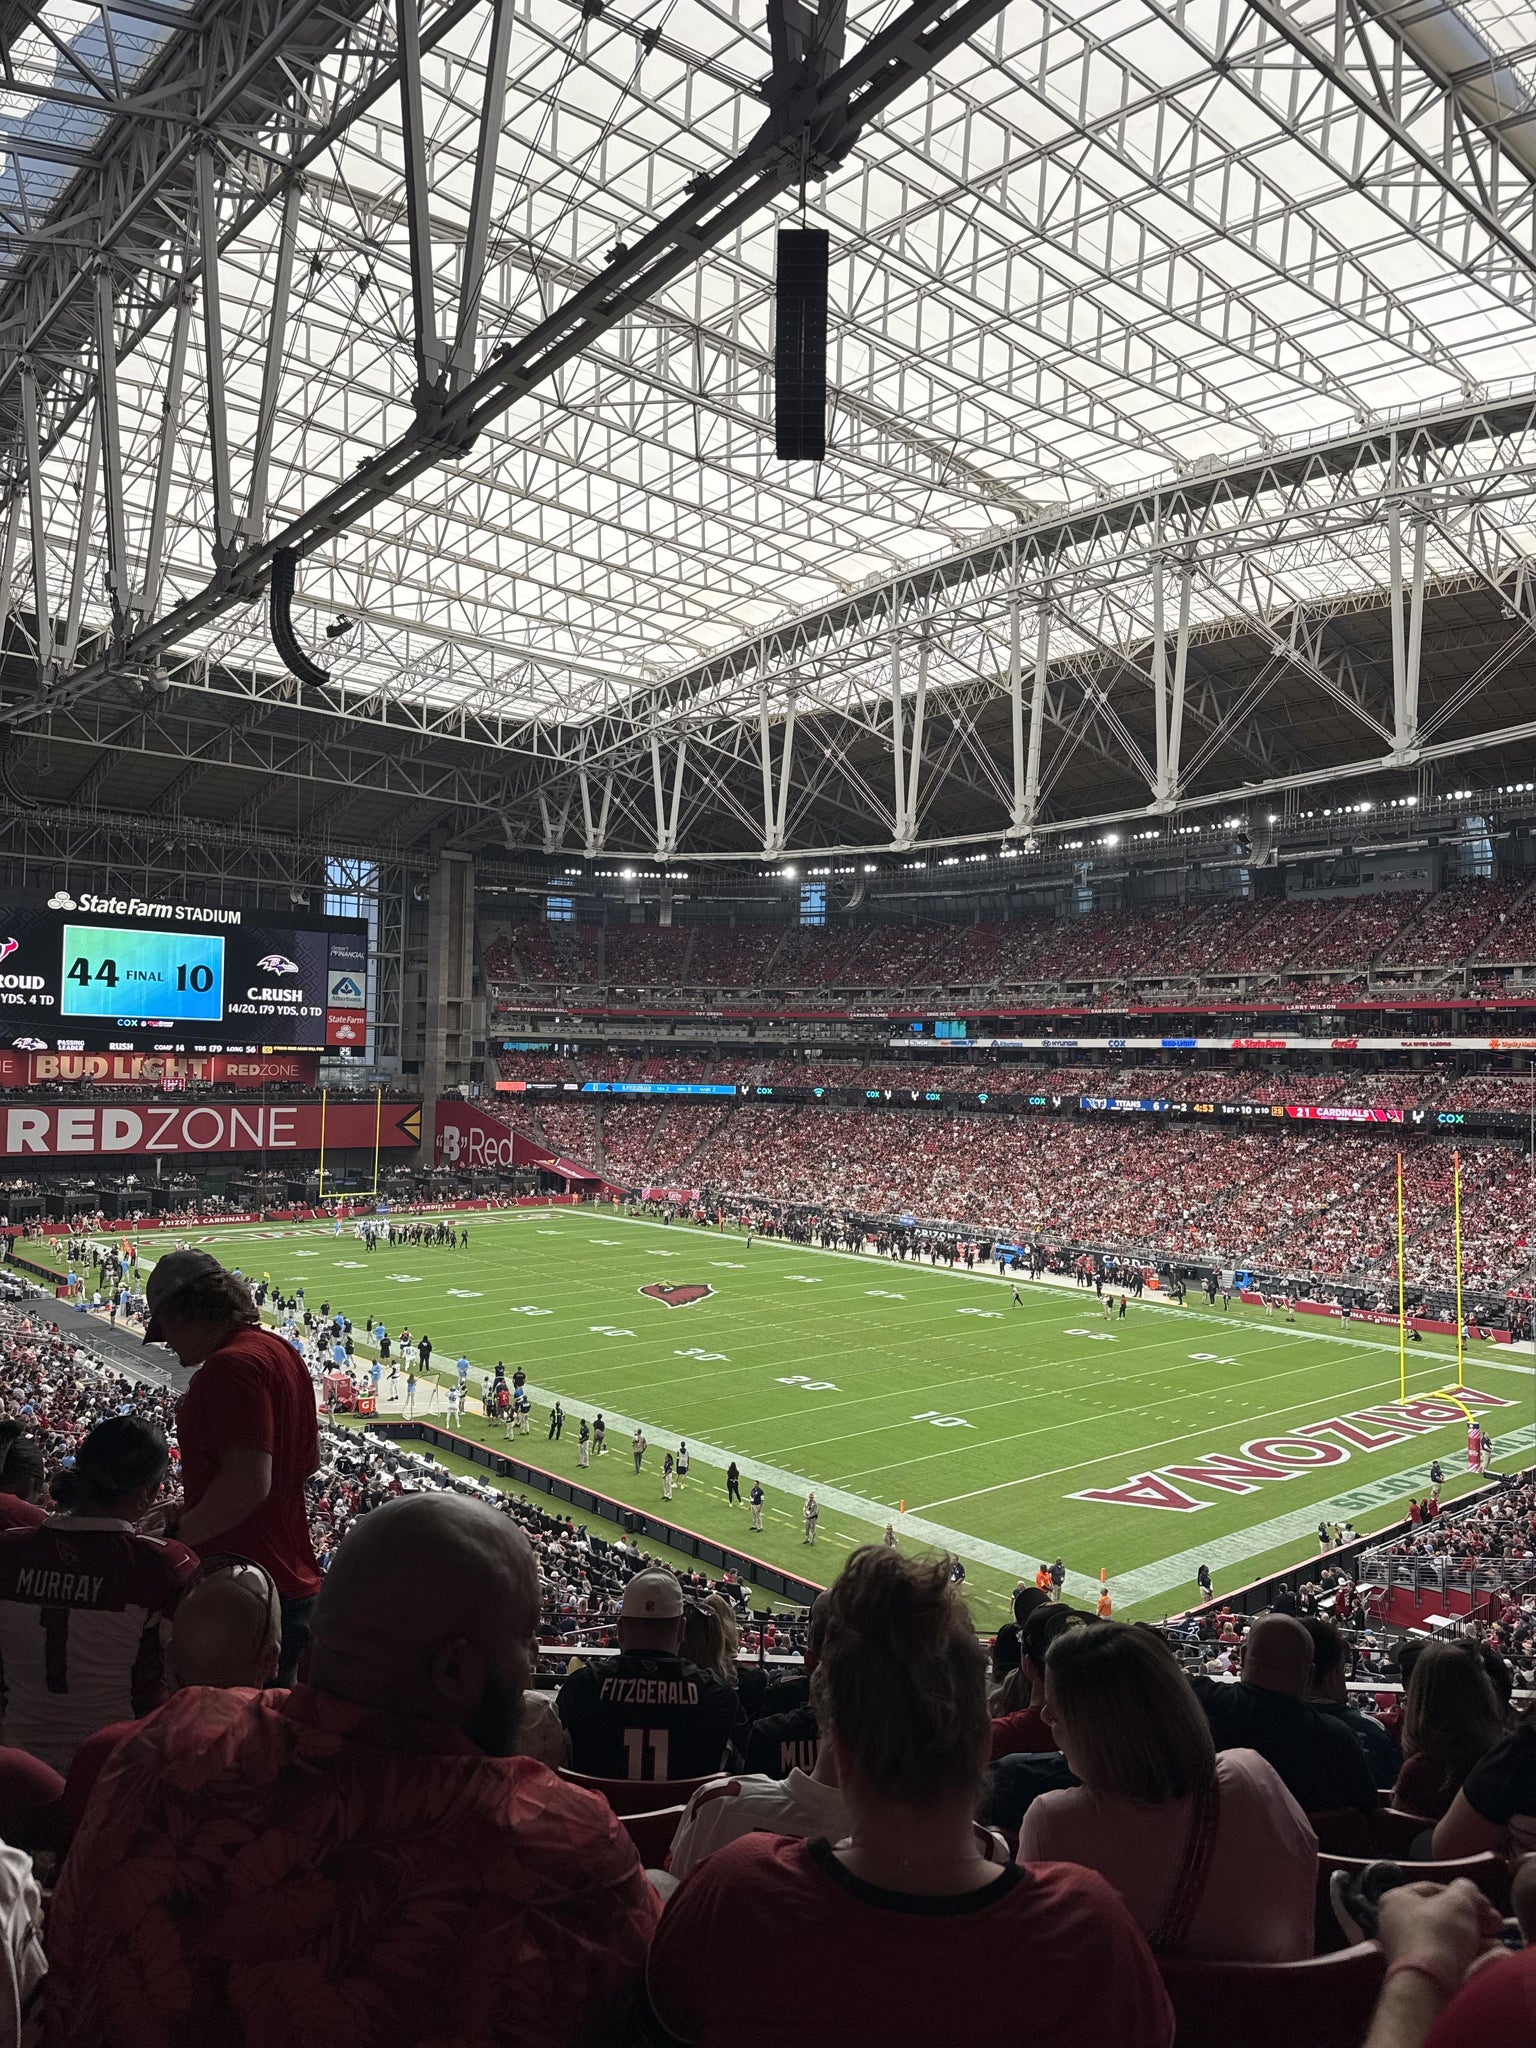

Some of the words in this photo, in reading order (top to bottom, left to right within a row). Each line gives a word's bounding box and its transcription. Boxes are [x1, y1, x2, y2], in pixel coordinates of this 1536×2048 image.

[175, 906, 241, 925] STADIUM
[67, 957, 119, 987] 44
[126, 970, 164, 982] FINAL
[176, 963, 213, 992] 10
[29, 994, 38, 1005] 4
[39, 995, 55, 1006] TD
[247, 987, 303, 1002] C.RUSH
[259, 1005, 275, 1014] 179
[300, 1006, 306, 1016] 0
[310, 1006, 322, 1016] TD
[117, 1019, 138, 1027] COX
[109, 1042, 134, 1051] RUSH
[175, 1044, 185, 1052] 14
[341, 1047, 351, 1056] 25
[0, 1060, 13, 1073] E
[36, 1055, 108, 1079] BUD
[114, 1056, 208, 1080] LIGHT
[227, 1064, 299, 1076] REDZONE
[756, 1087, 773, 1095] COX
[866, 1090, 880, 1098] COX
[925, 1092, 941, 1101] COX
[1029, 1097, 1046, 1105] COX
[1115, 1099, 1141, 1108] TITANS
[1153, 1102, 1160, 1111] 6
[1180, 1103, 1187, 1112] 2
[1194, 1103, 1214, 1113] 4:53
[1222, 1105, 1235, 1114] 1ST
[1241, 1105, 1252, 1114] 10
[1296, 1107, 1310, 1117] 21
[1316, 1107, 1369, 1118] CARDINALS
[1438, 1113, 1464, 1124] COX
[7, 1108, 297, 1152] REDZONE
[416, 1203, 456, 1212] CARDIALS
[159, 1216, 199, 1227] ARIZOA
[202, 1215, 250, 1225] CARDINALS
[510, 1305, 554, 1316] 50
[588, 1325, 636, 1337] 40
[1063, 1329, 1118, 1341] 20
[674, 1348, 727, 1362] 30
[1187, 1353, 1238, 1365] 10
[773, 1375, 836, 1391] 20
[361, 1400, 369, 1409] G
[910, 1410, 970, 1428] 10
[1062, 1383, 1522, 1514] ARIZONA
[1374, 1476, 1420, 1496] OF
[1330, 1491, 1377, 1511] US
[15, 1567, 104, 1603] MURRAY
[40, 1607, 71, 1695] 1
[600, 1678, 699, 1705] FITZGERALD
[623, 1727, 669, 1781] 11
[780, 1740, 821, 1773] MU
